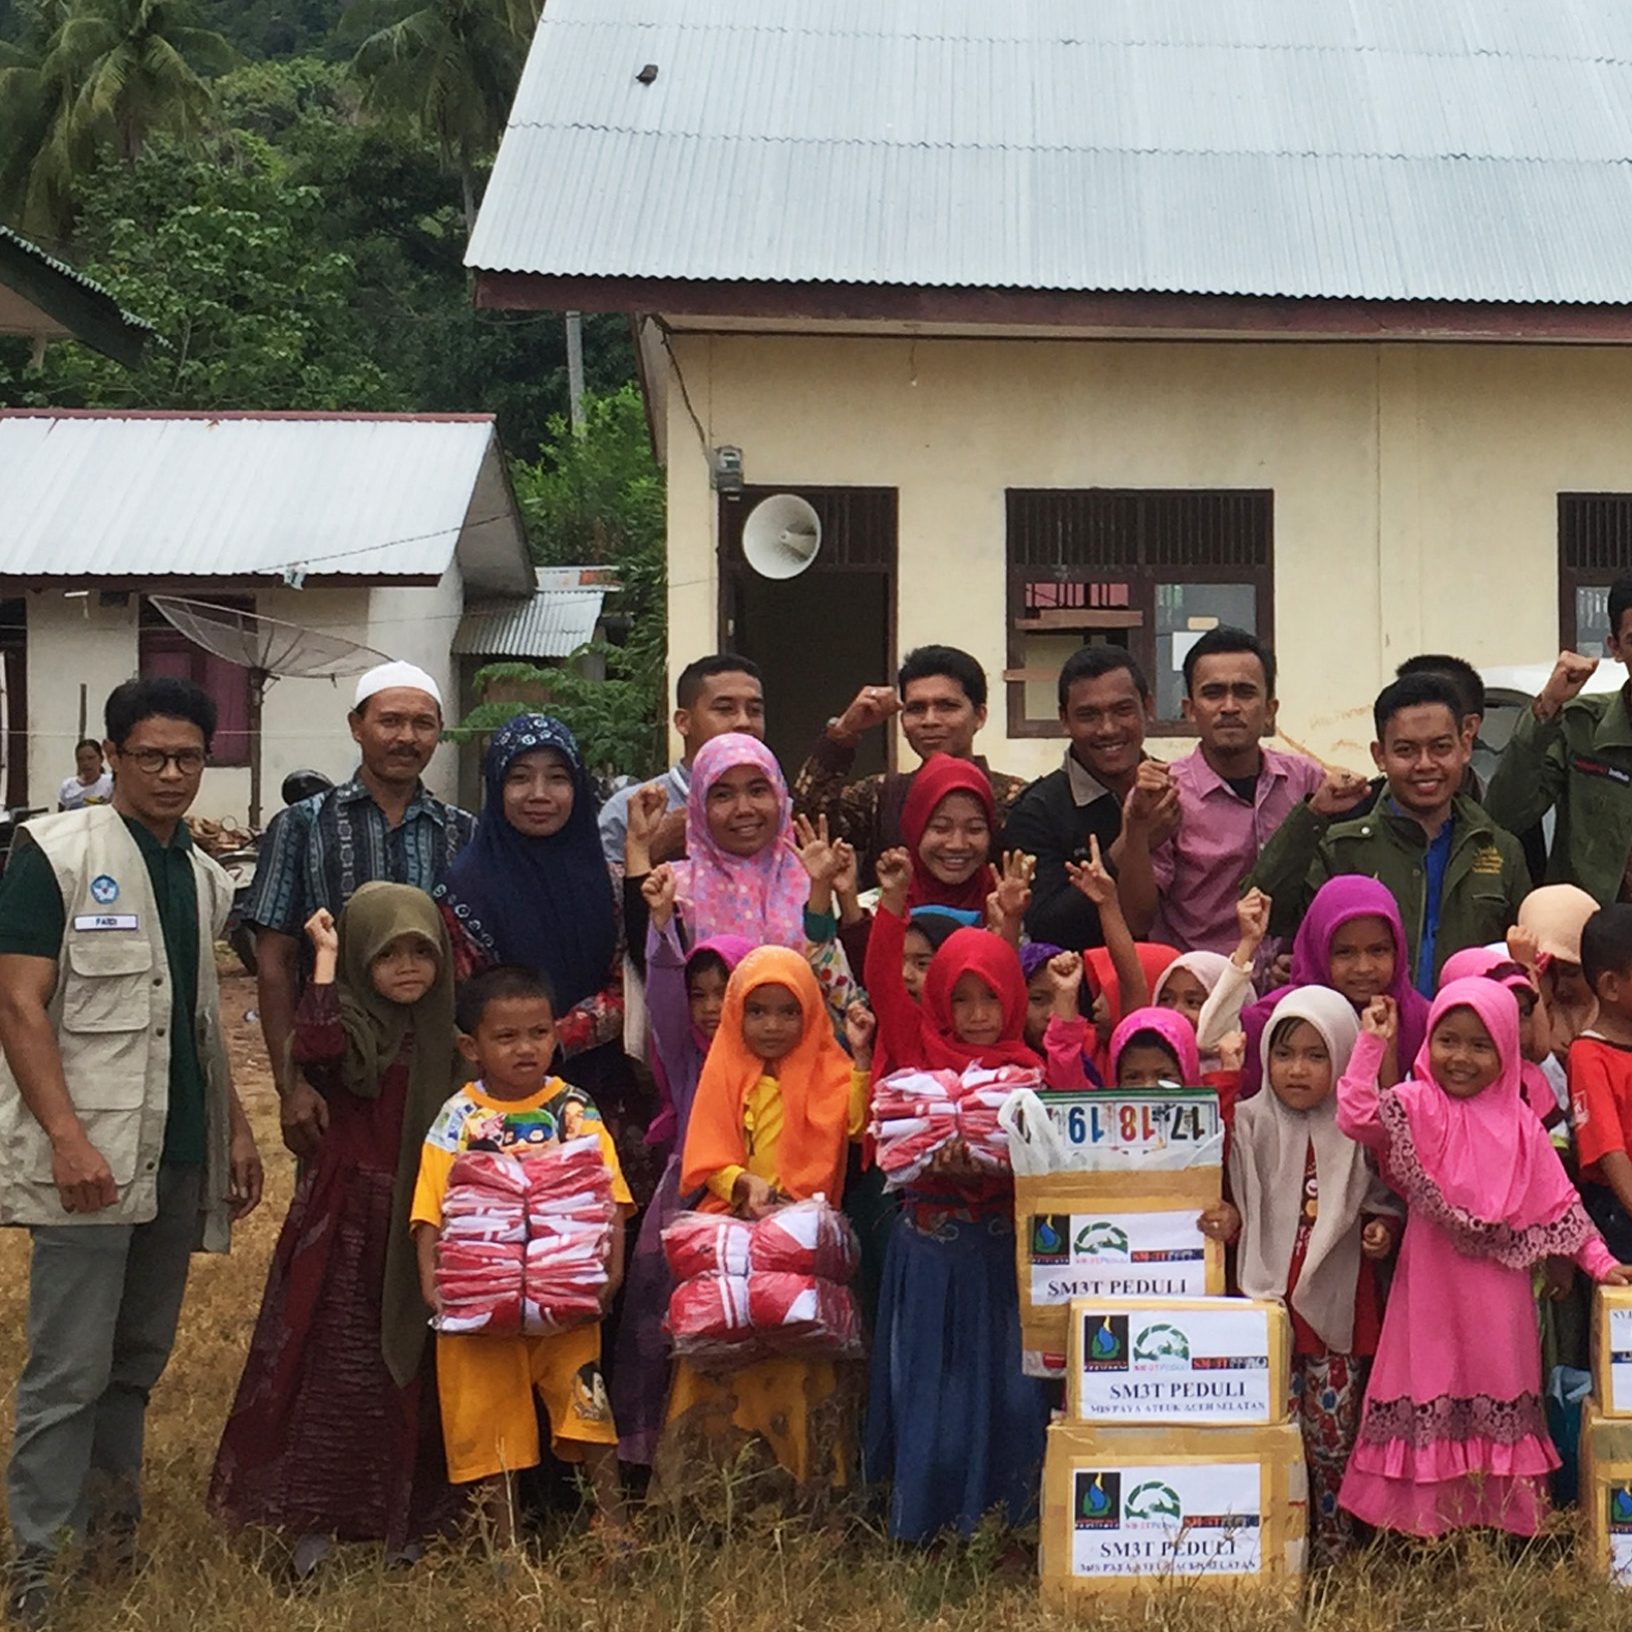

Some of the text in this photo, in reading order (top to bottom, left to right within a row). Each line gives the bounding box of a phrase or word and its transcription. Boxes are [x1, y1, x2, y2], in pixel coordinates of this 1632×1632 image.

[1068, 1106, 1104, 1143] 19
[1119, 1105, 1155, 1140] 18
[1171, 1106, 1205, 1140] 17
[1048, 1279, 1187, 1296] SM3T PEDULI
[1110, 1381, 1246, 1399] SM3T PEDULI
[1100, 1540, 1236, 1557] SM3T PEDULI
